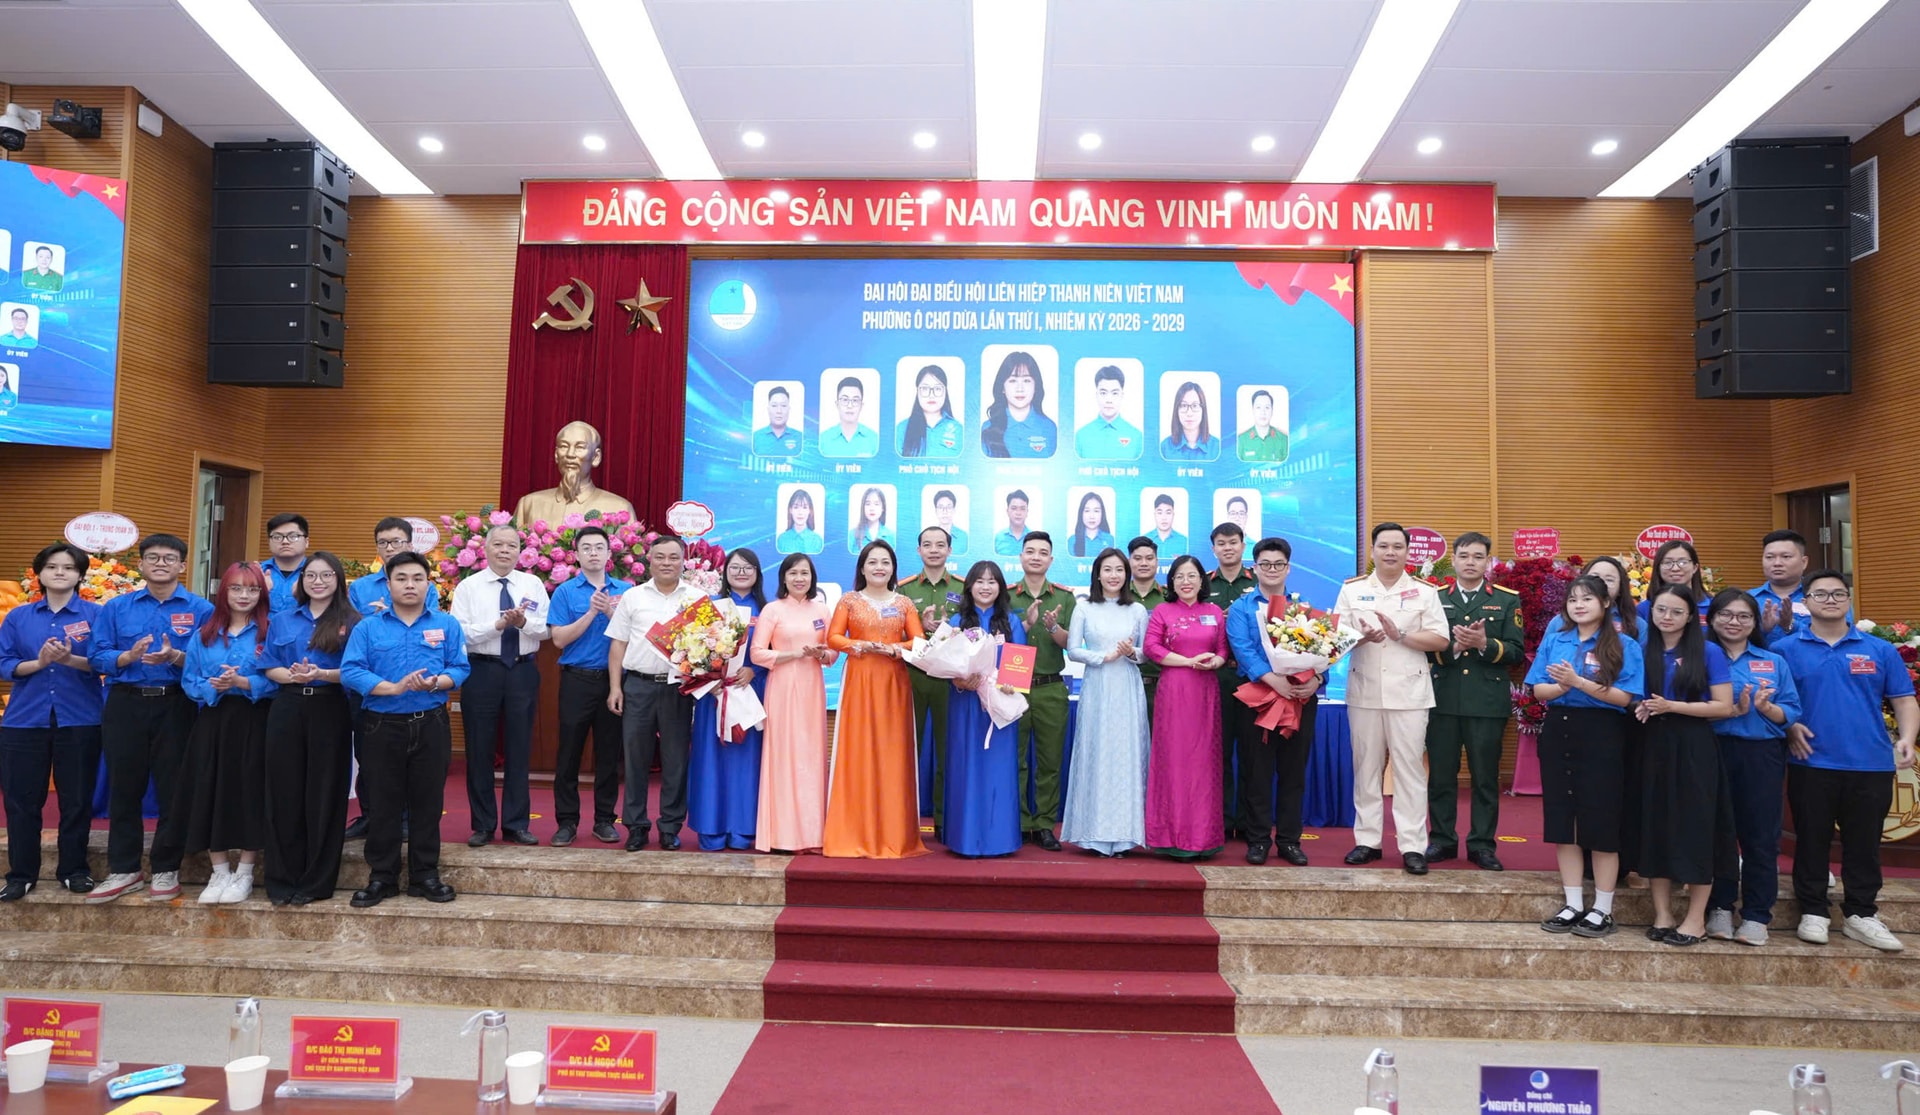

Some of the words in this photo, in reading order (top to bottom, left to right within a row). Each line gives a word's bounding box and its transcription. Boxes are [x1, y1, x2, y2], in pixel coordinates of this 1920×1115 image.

[583, 188, 666, 226] ĐẢNG
[682, 190, 775, 232] CỘNG
[788, 188, 854, 226] SẢN
[864, 192, 930, 231] VIỆT
[946, 198, 1016, 226] NAM
[1030, 198, 1144, 228] QUANG
[1156, 200, 1232, 229] VINH
[1245, 193, 1338, 230] MUÔN
[864, 283, 884, 303] ĐẠI
[888, 281, 908, 304] HỘI
[911, 283, 932, 303] ĐẠI
[965, 281, 986, 304] HỘI
[989, 281, 1016, 302] LIÊN
[1019, 282, 1046, 304] HIỆP
[1050, 284, 1091, 302] THANH
[1094, 282, 1122, 302] NIÊN
[1126, 282, 1152, 304] VIỆT
[1156, 286, 1184, 303] NAM
[862, 309, 911, 330] PHƯỜNG
[914, 309, 922, 330] Ô
[925, 310, 950, 332] CHỢ
[1008, 310, 1033, 330] THỨ
[1046, 310, 1085, 332] NHIỆM
[1088, 310, 1106, 331] KỲ
[1108, 314, 1140, 331] 2026
[1152, 314, 1185, 332] 2029
[1488, 1098, 1526, 1112] NGUYỄN
[1528, 1102, 1566, 1114] PHƯƠNG
[1568, 1100, 1592, 1114] THẢO
